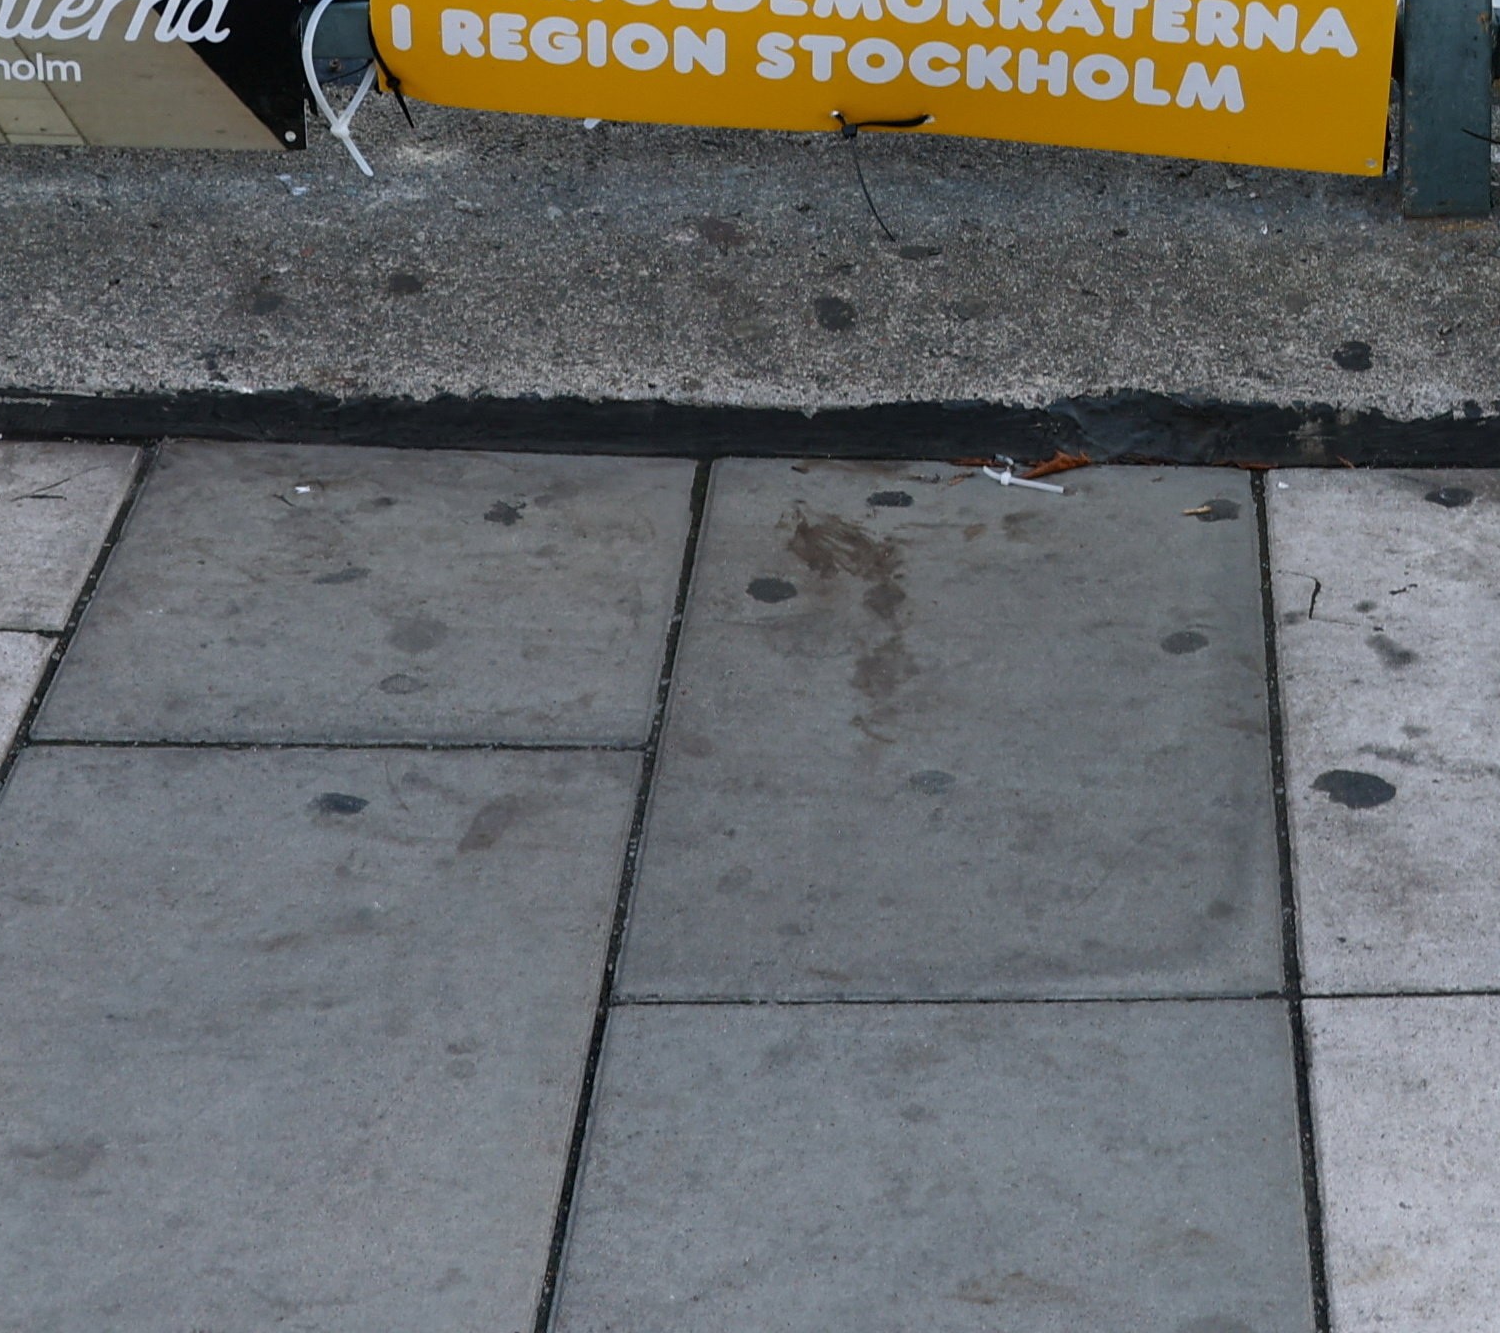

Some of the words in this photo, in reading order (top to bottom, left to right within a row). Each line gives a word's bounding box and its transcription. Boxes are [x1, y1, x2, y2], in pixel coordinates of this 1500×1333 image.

[391, 4, 412, 52] I
[441, 6, 727, 77] REGION
[755, 32, 1246, 115] STOCKHOLM
